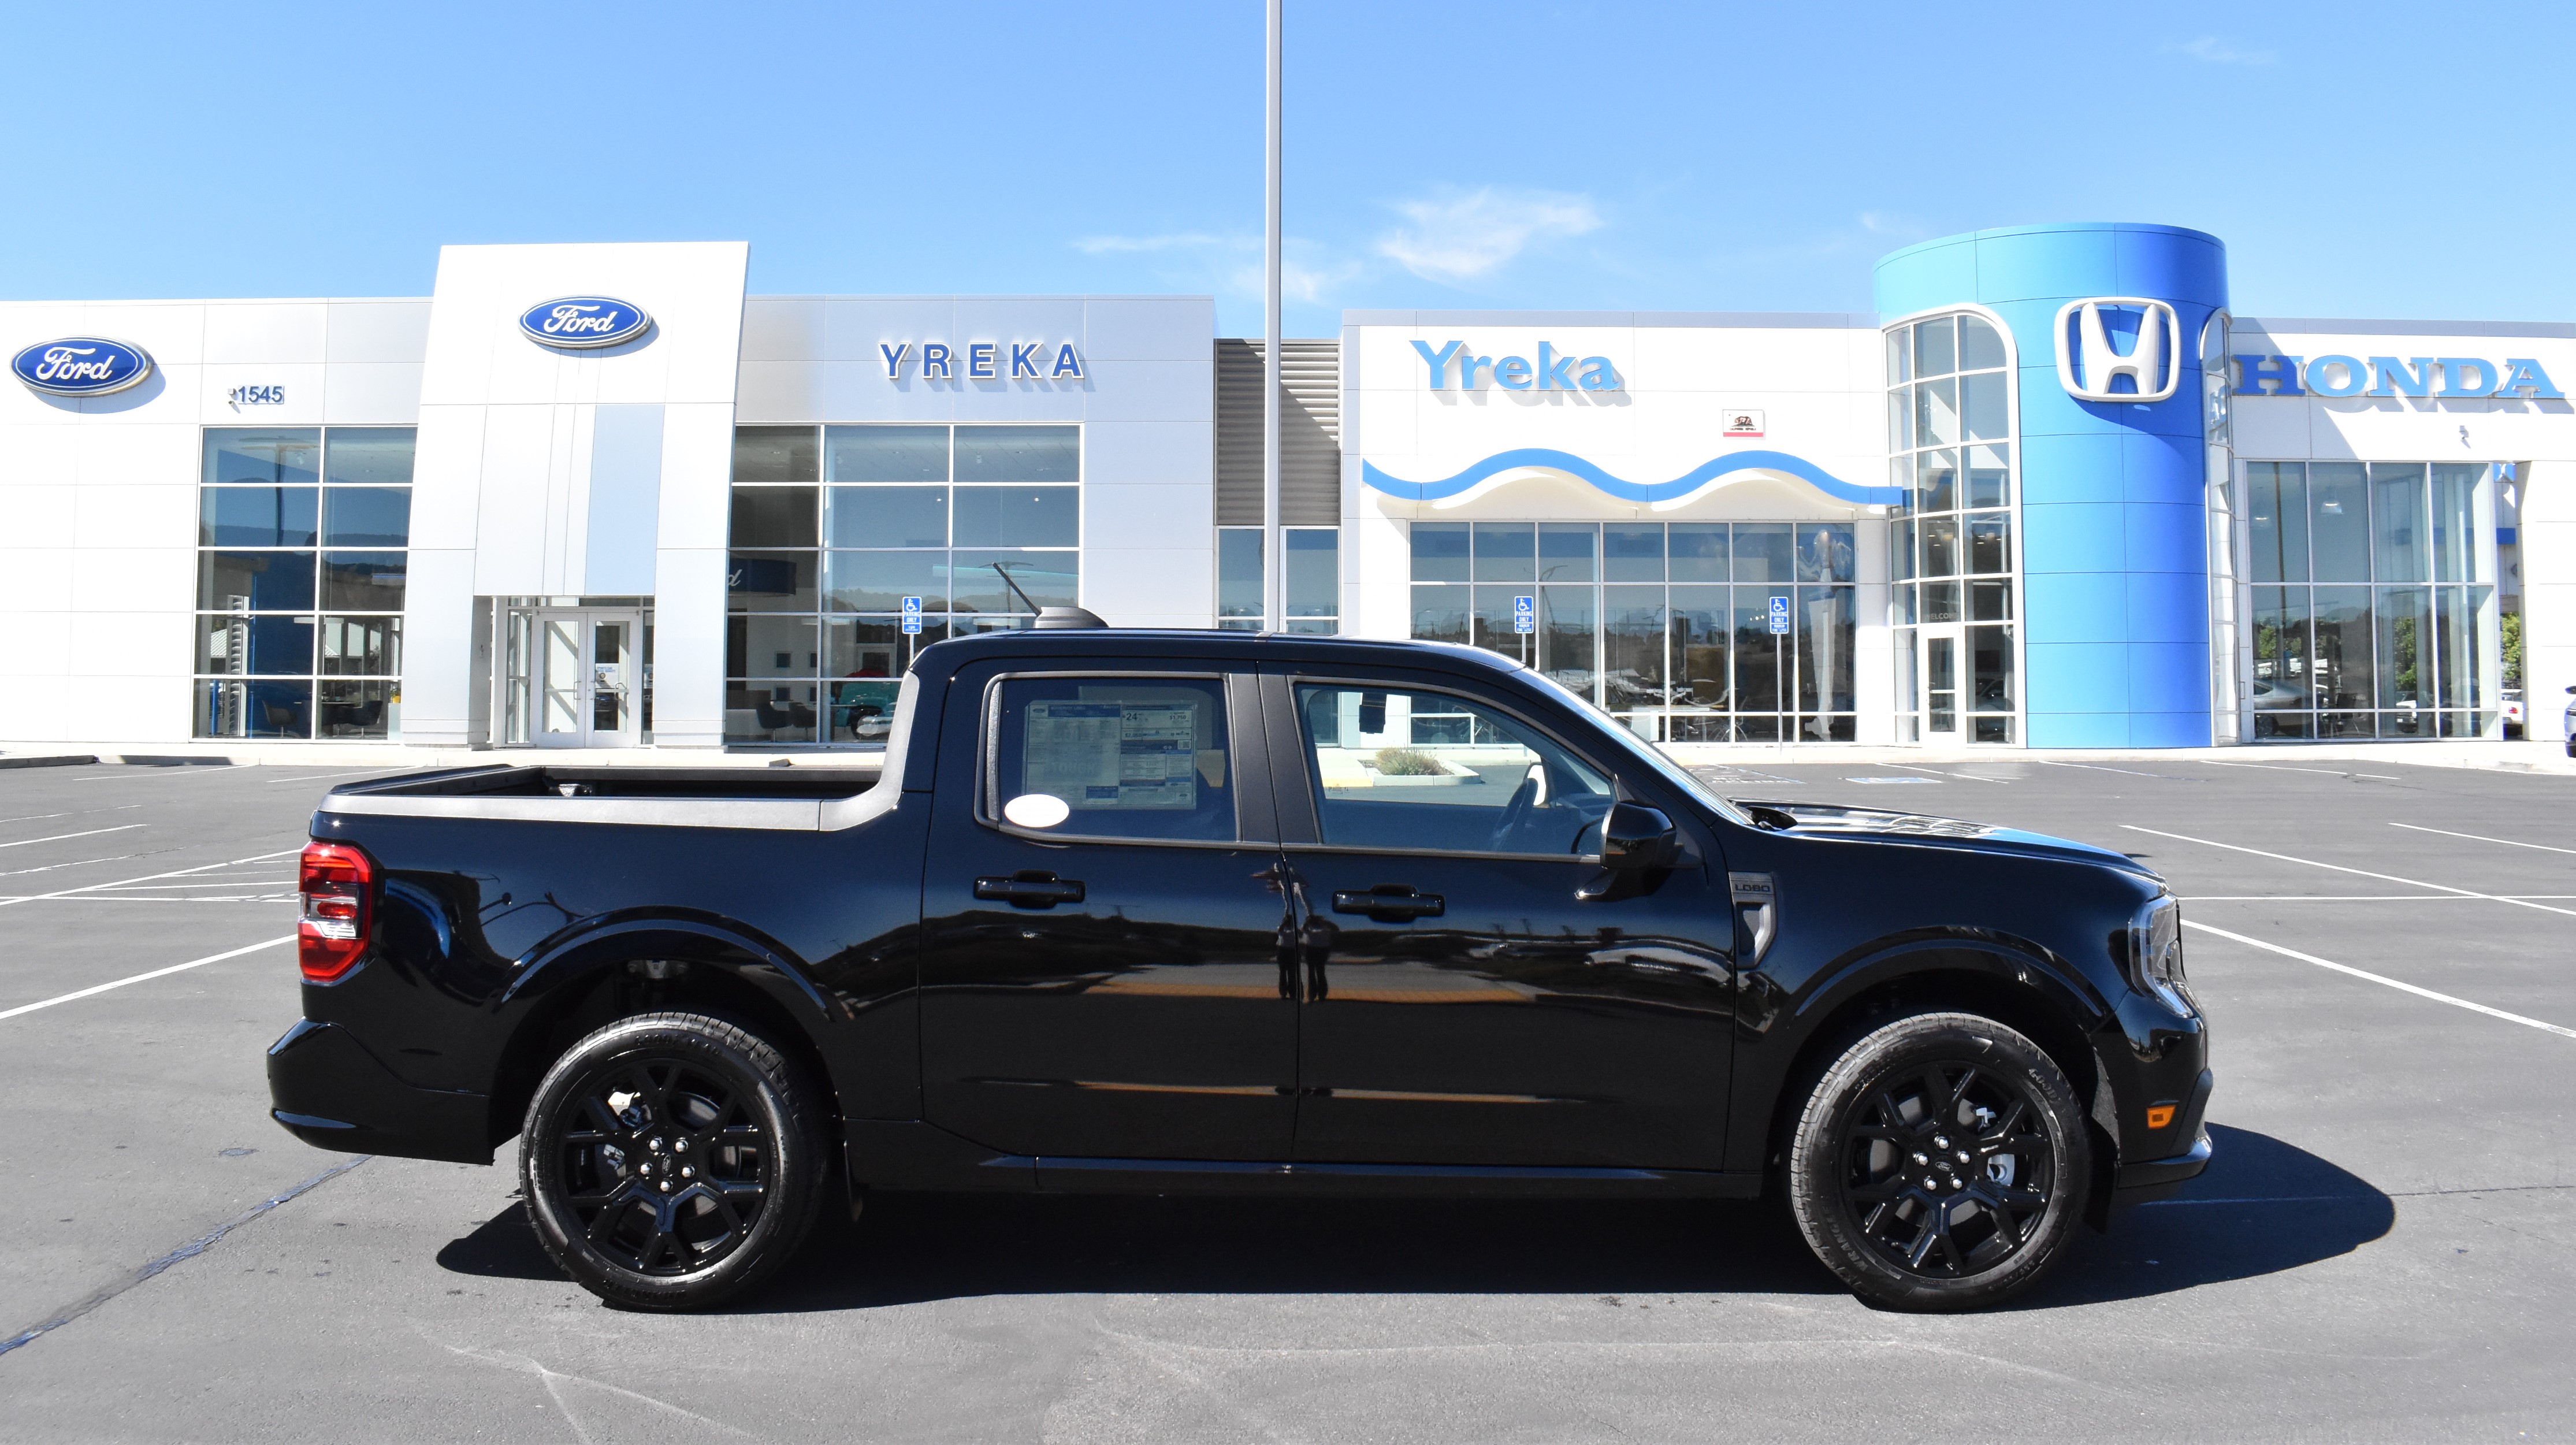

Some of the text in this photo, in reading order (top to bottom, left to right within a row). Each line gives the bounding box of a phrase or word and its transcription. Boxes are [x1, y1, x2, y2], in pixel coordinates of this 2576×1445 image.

[544, 304, 617, 333] Ford
[36, 347, 114, 380] Ford
[878, 341, 1085, 379] YREKA
[1410, 340, 1620, 392] Yreka
[2232, 354, 2566, 399] HONDA
[238, 386, 283, 403] 1545
[1822, 1205, 1868, 1272] WRANGLE
